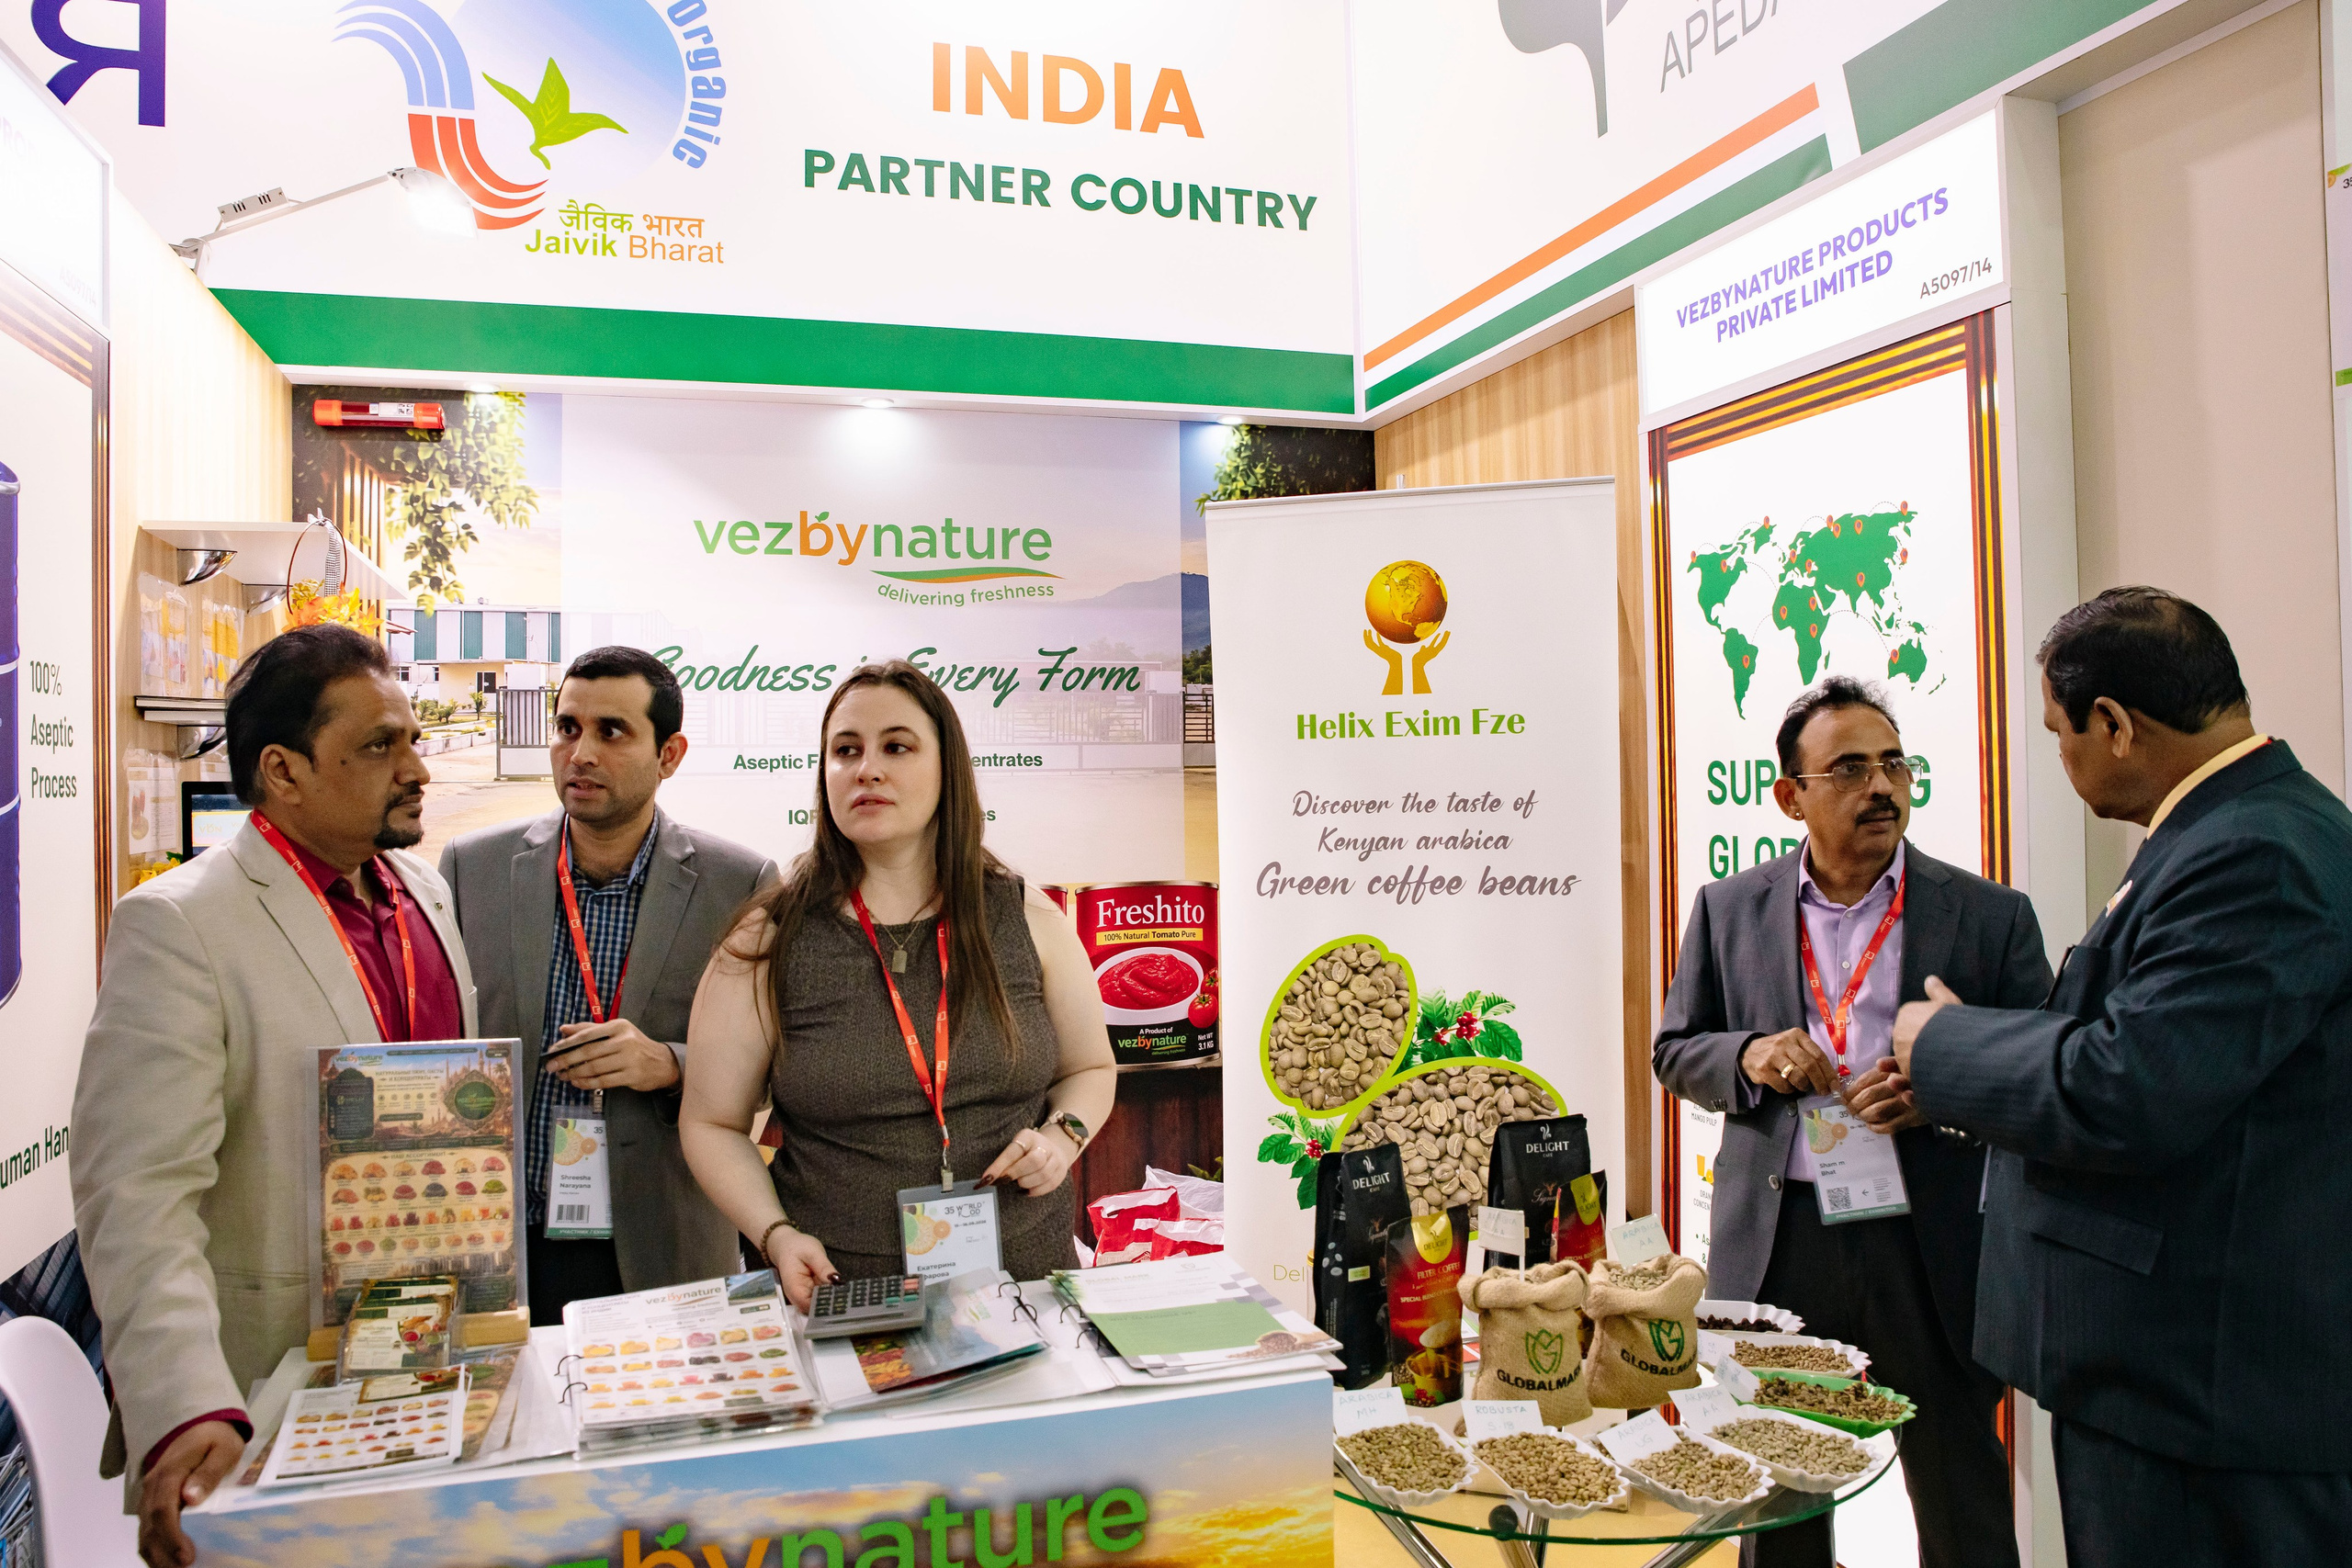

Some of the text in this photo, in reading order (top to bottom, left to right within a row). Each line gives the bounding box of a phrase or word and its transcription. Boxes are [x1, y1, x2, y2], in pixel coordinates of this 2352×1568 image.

[1660, 0, 1778, 94] APED
[667, 0, 727, 169] Organic
[932, 41, 1204, 139] INDIA
[804, 149, 1317, 231] PARTNER COUNTRY
[558, 199, 705, 238] जैविक भारत
[525, 229, 724, 264] Jaivik Bharat
[1677, 187, 1949, 329] VEZBYNATURE PRODUCTS
[1920, 257, 1993, 299] A5097/14
[1716, 250, 1893, 343] PRIVATE LIMITED
[694, 511, 1053, 566] vezbynature
[877, 582, 1054, 607] delivering freshness
[30, 660, 62, 695] 100%
[650, 645, 837, 692] Goodness
[907, 647, 1020, 708] Every
[1037, 647, 1141, 692] Form
[31, 714, 74, 754] Aseptic
[1296, 707, 1526, 740] Helix Exim Fze
[733, 754, 804, 773] Aseptic
[971, 753, 1044, 767] entrates
[31, 767, 77, 798] Process
[1293, 789, 1539, 819] Discover the taste of
[1317, 826, 1514, 862] Kenyan arabica
[1256, 861, 1583, 906] Green coffee beans
[1096, 895, 1205, 928] Freshito
[1103, 930, 1196, 942] 100% Natural Tomato Pure
[1117, 1034, 1187, 1050] vezbynature
[1198, 1042, 1206, 1051] 3.1
[594, 1126, 604, 1134] 35
[1839, 1111, 1849, 1119] 35
[0, 1125, 70, 1190] uman Han
[1526, 1140, 1570, 1154] DELIGHT
[1351, 1172, 1391, 1190] DELIGHT
[1700, 1190, 1712, 1200] ORAN
[944, 1206, 955, 1215] 35
[1693, 1198, 1712, 1211] CONCEN
[1273, 1265, 1305, 1282] Del
[645, 1286, 722, 1305] vezbynature
[1620, 1346, 1697, 1376] GLOBALMA
[1339, 1390, 1394, 1406] ARABICA
[1476, 1404, 1528, 1415] ROBUSTA
